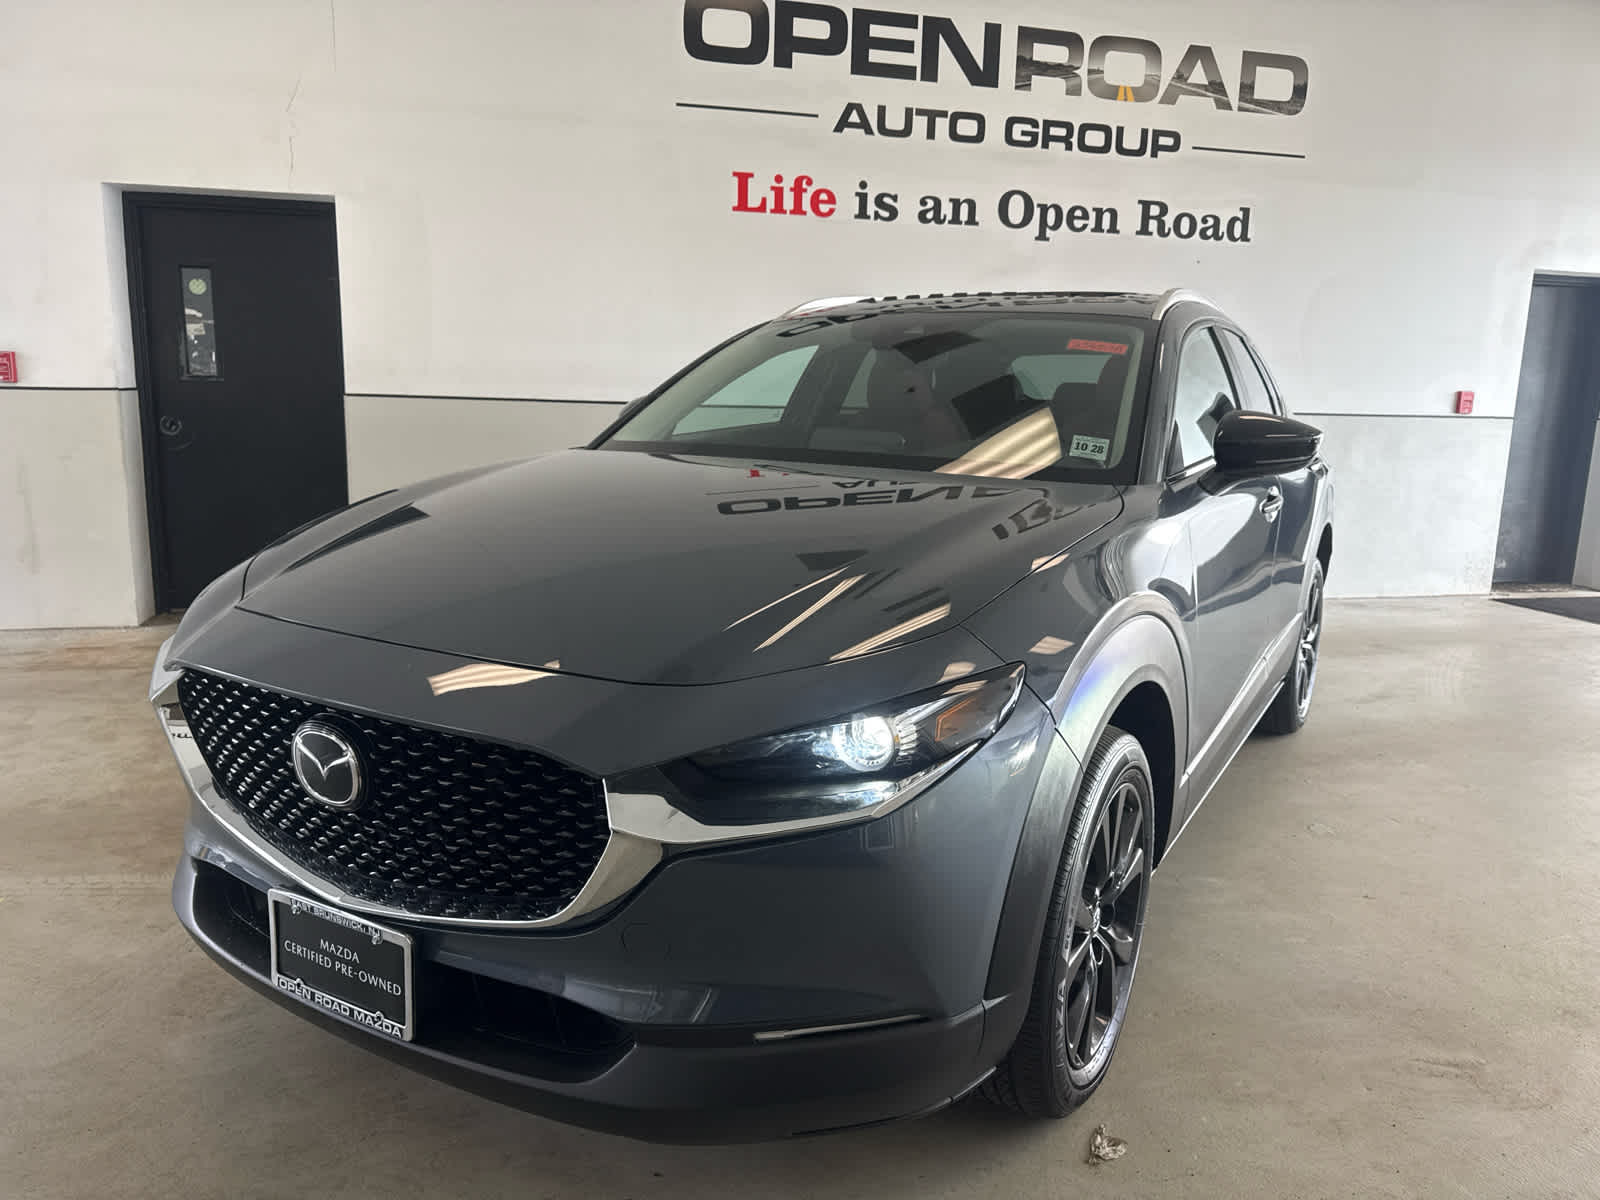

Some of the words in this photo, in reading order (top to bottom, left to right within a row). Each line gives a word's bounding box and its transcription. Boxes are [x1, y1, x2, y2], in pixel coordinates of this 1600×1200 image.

[683, 0, 1001, 88] OPEN
[1014, 25, 1309, 116] ROAD
[833, 102, 986, 144] AUTO
[1004, 116, 1182, 159] GROUP
[732, 171, 837, 219] Life
[854, 180, 898, 222] is
[918, 195, 979, 227] an
[998, 189, 1121, 242] Open
[1135, 199, 1251, 243] Road
[1074, 441, 1088, 452] 10
[1090, 444, 1105, 454] 28
[284, 939, 332, 969] CERTIFIED
[335, 960, 402, 997] PRE-OWNED
[320, 939, 360, 964] MAZDA
[279, 978, 311, 1000] OPEN
[315, 992, 349, 1016] ROAD
[354, 1009, 402, 1038] MAZDA
